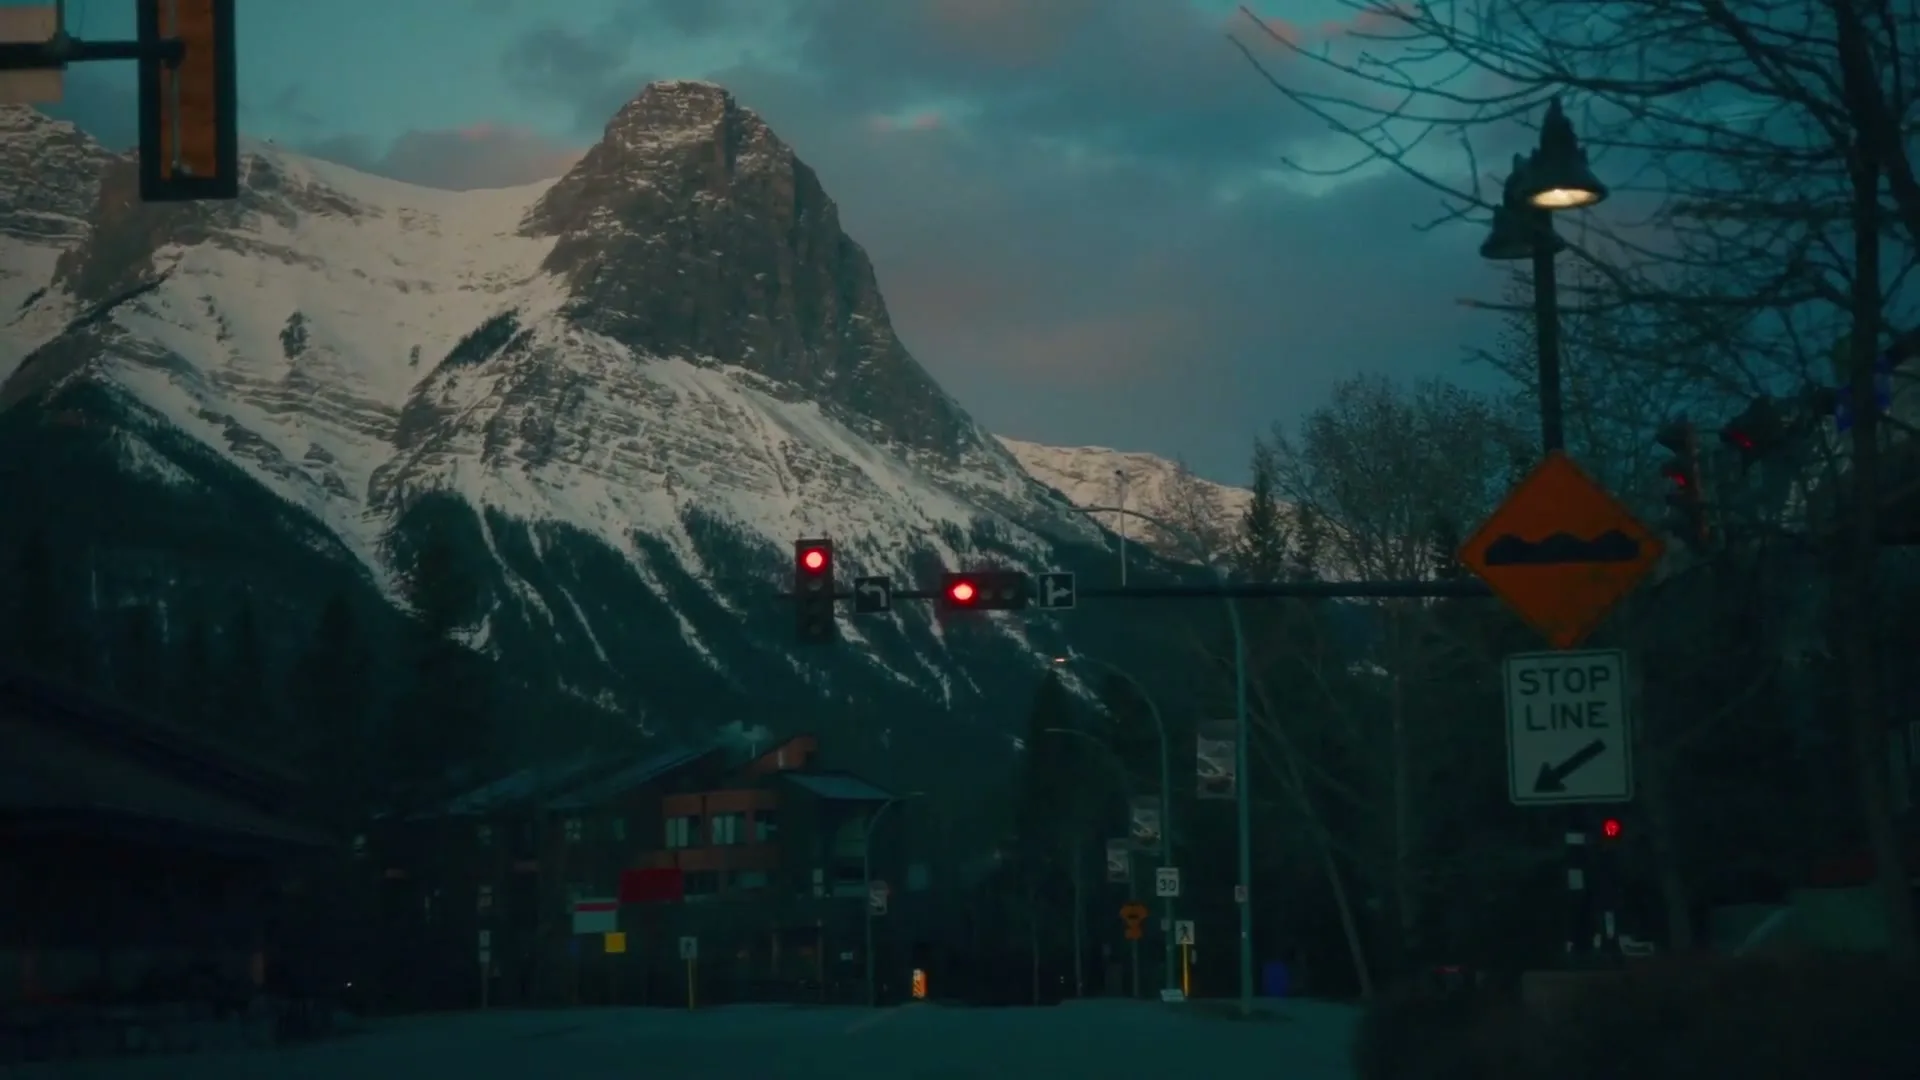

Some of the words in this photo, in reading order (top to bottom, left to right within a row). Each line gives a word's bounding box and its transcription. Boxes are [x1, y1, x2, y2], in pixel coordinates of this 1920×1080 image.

[1518, 665, 1610, 696] STOP
[1525, 701, 1609, 731] LINE
[1159, 879, 1177, 891] 30
